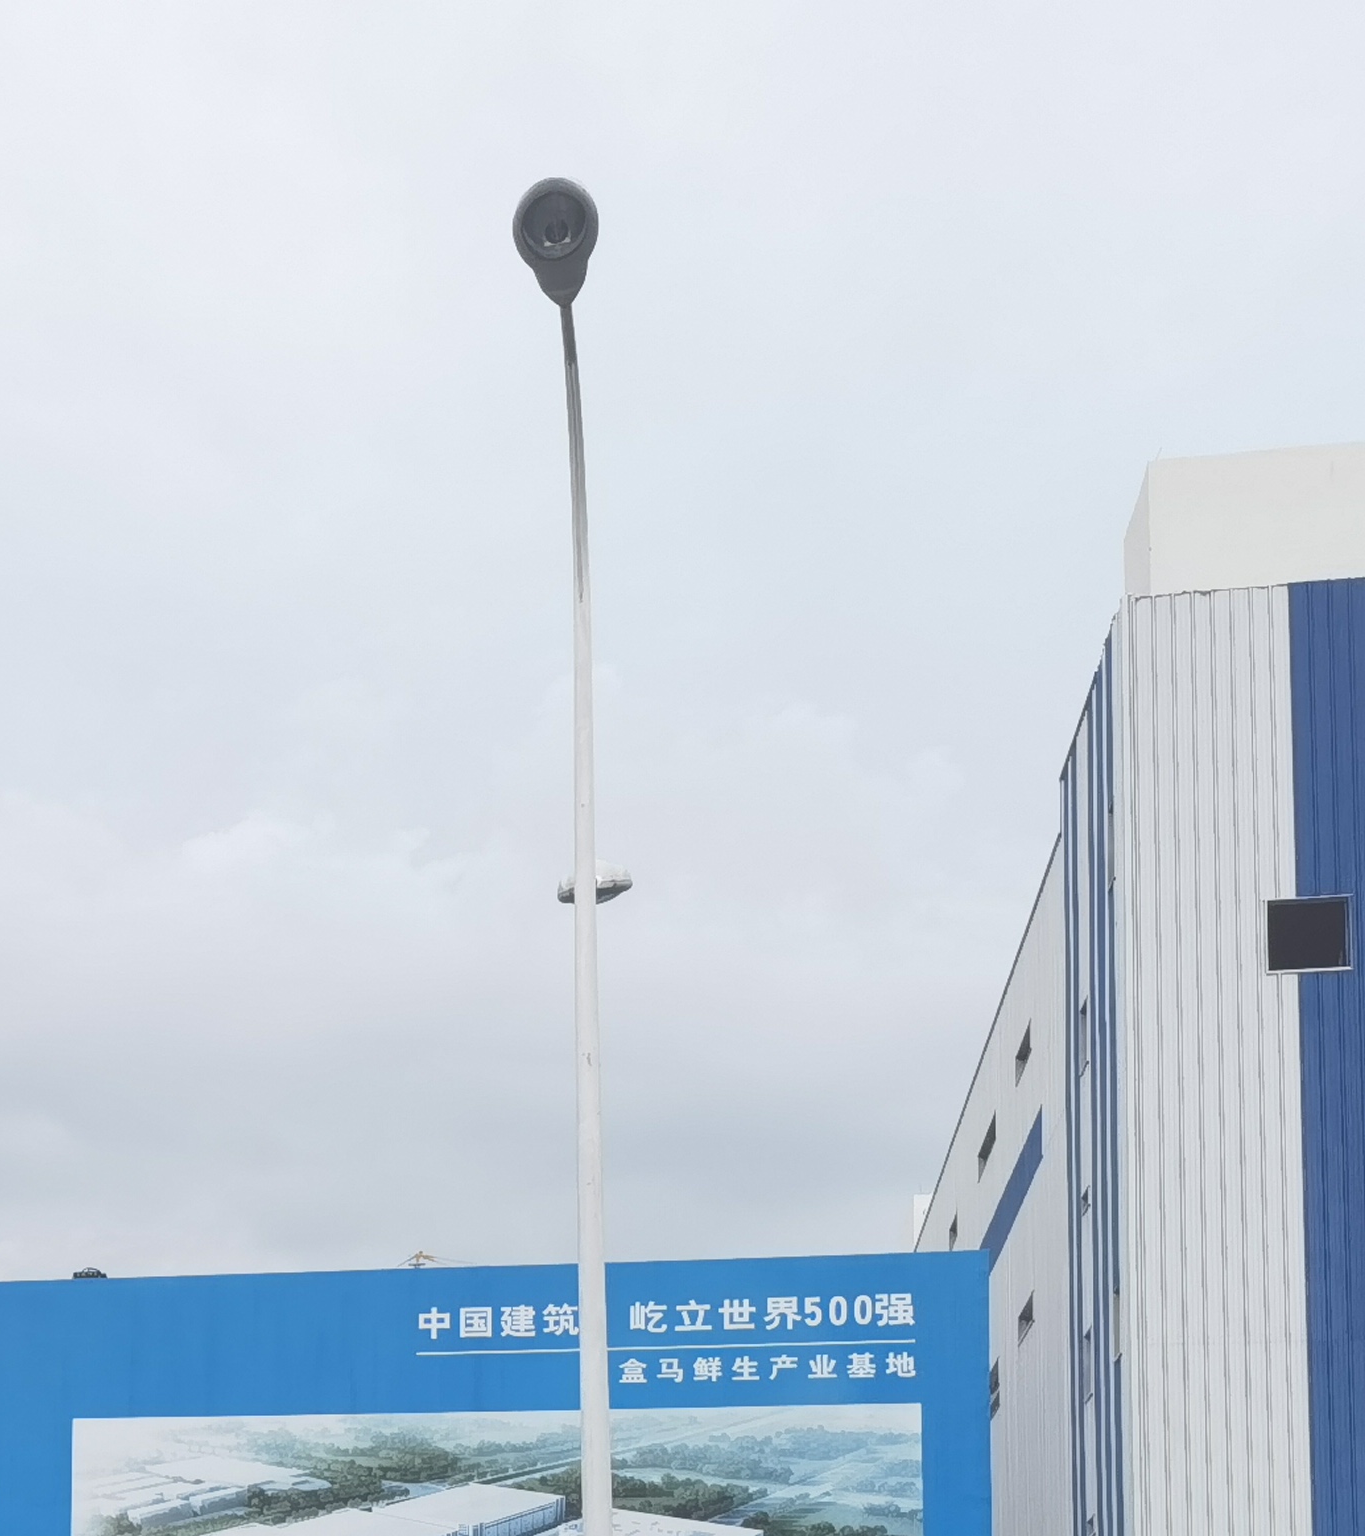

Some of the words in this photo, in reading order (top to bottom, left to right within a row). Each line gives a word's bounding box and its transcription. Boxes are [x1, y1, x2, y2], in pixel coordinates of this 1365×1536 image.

[417, 1302, 580, 1341] 中国建筑
[628, 1291, 916, 1334] 屹立世界500强
[618, 1350, 917, 1385] 盒马鲜生产业基地
